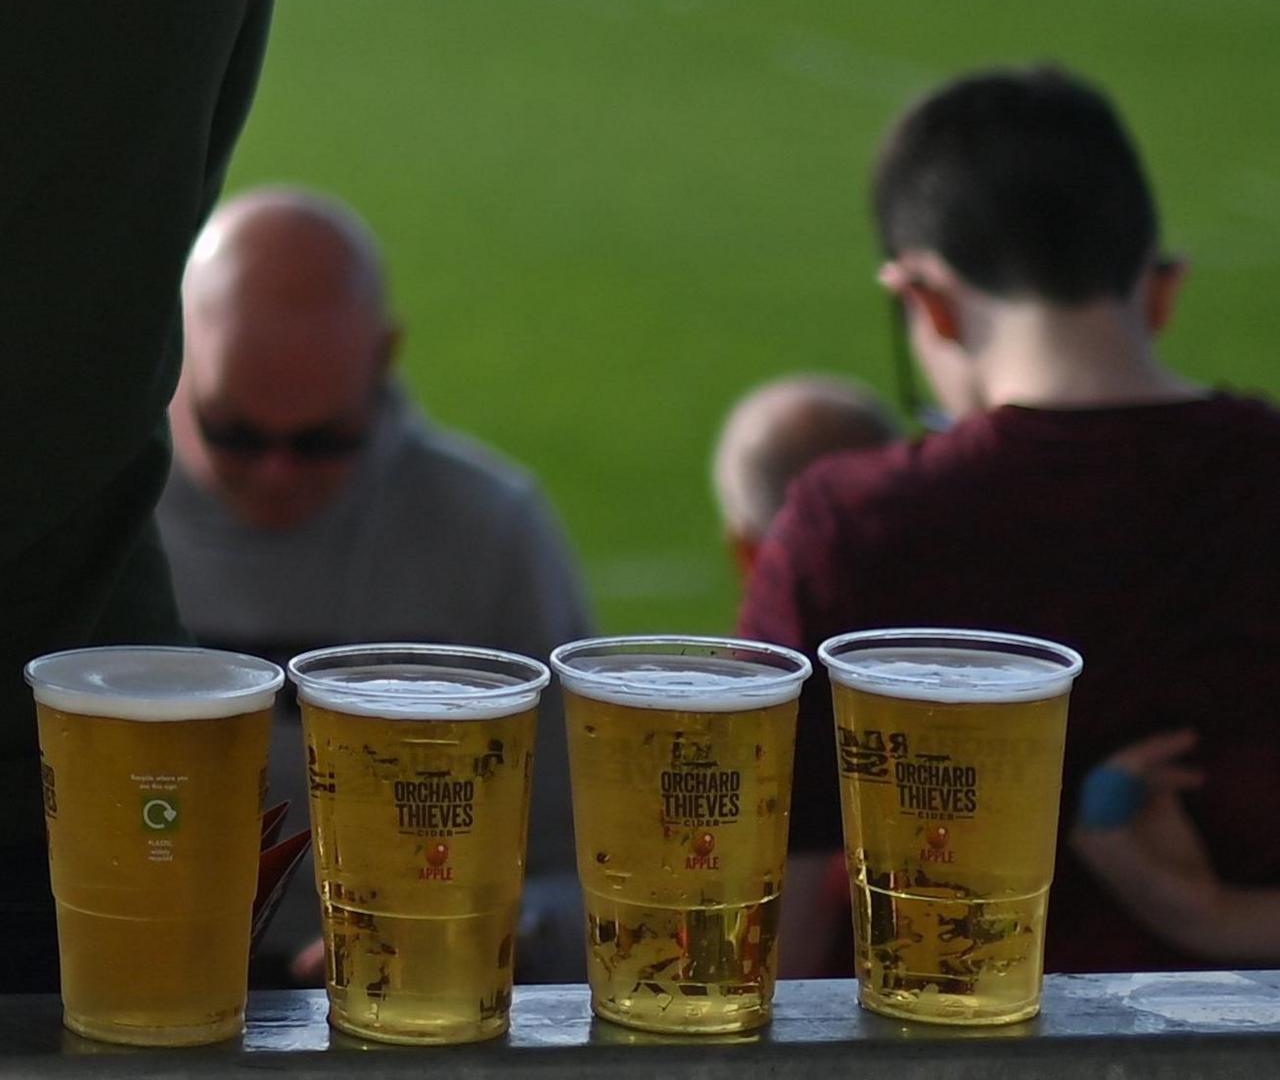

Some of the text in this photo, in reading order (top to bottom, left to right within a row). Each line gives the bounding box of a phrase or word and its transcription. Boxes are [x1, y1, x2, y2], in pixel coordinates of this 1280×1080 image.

[660, 770, 740, 794] ORCHARD
[894, 761, 977, 788] ORCHARD
[394, 780, 474, 804] ORCHARD
[897, 785, 976, 813] THIEVES
[661, 792, 739, 818] THIEVES
[395, 803, 473, 829] THIEVES
[683, 819, 720, 828] CIDER
[917, 810, 955, 821] CIDER
[416, 828, 454, 837] CIDER
[685, 856, 719, 870] APPLE
[919, 850, 954, 864] APPLE
[419, 867, 453, 881] APPLE
